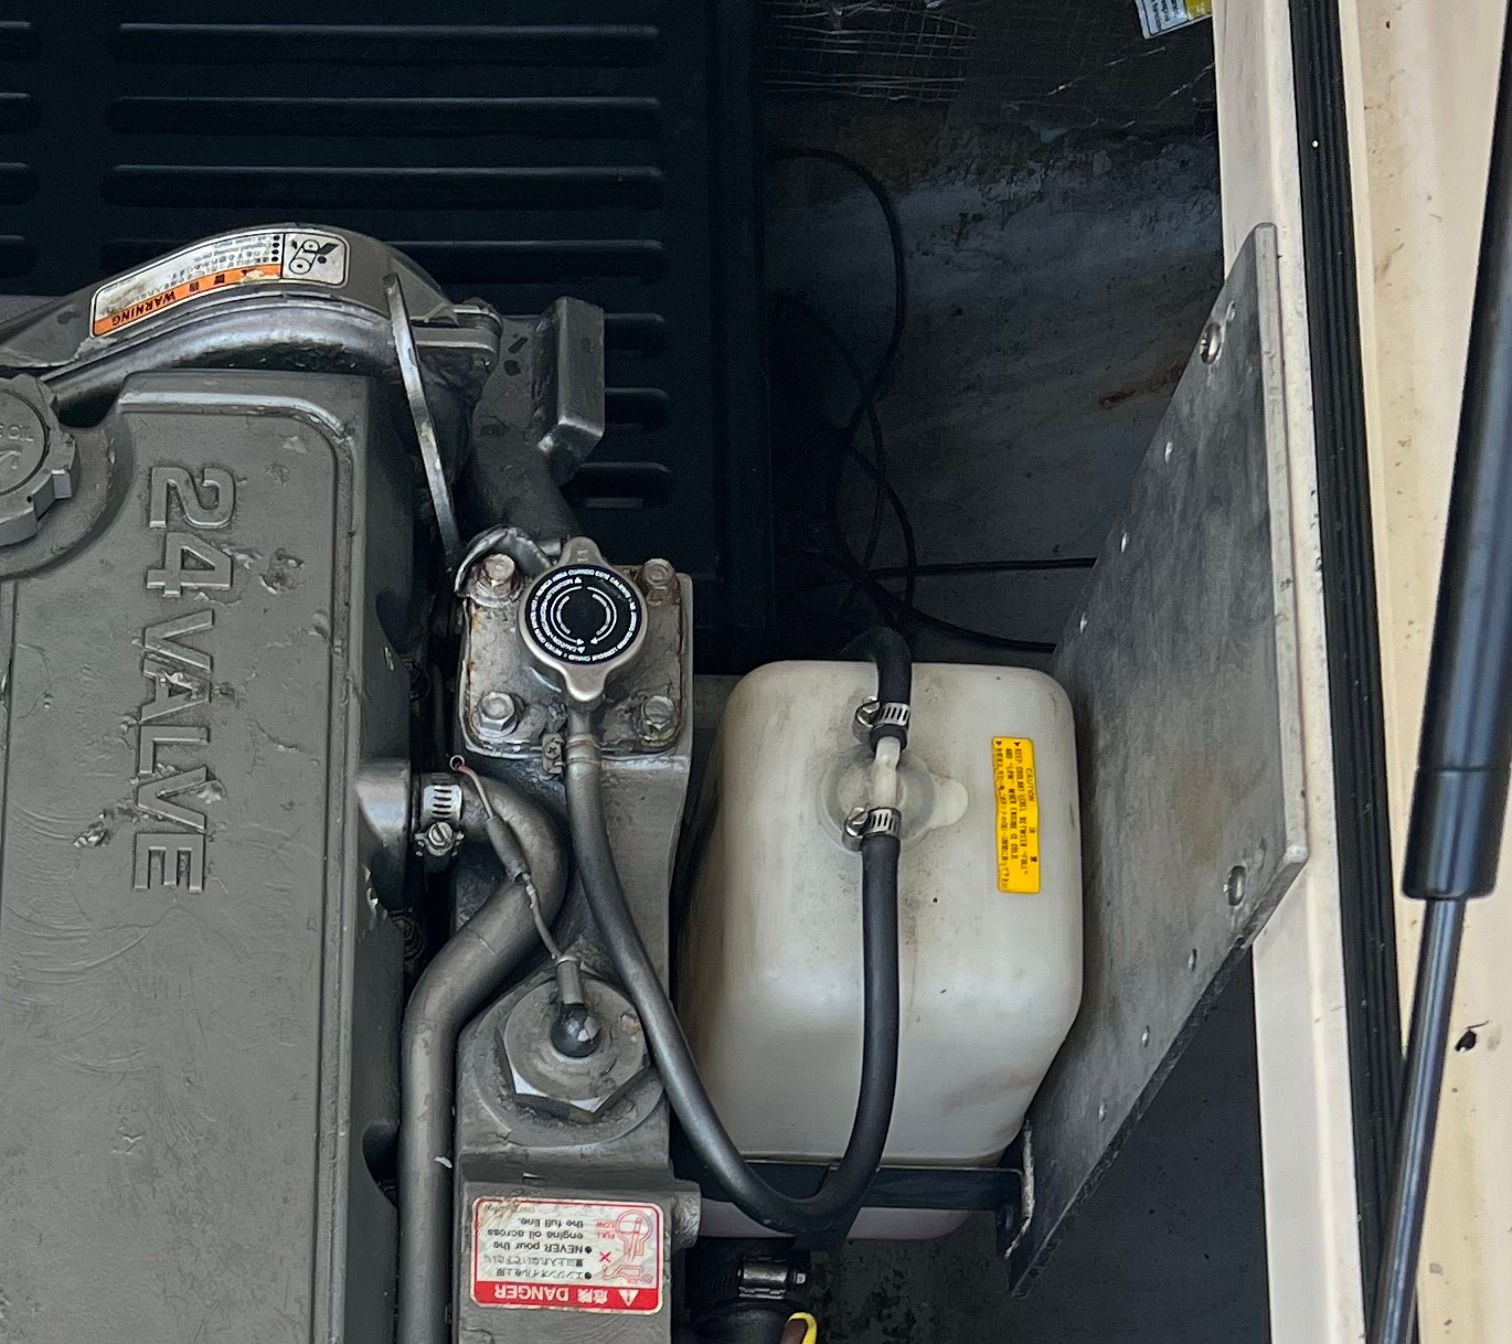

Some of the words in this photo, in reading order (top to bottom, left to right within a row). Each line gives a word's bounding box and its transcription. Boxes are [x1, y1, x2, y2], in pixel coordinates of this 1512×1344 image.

[111, 290, 176, 326] WARNING
[7, 424, 34, 442] OIL
[144, 464, 237, 598] 24
[131, 606, 214, 895] VALVE
[518, 1218, 540, 1227] line.
[545, 1220, 562, 1228] full
[566, 1220, 583, 1228] the
[488, 1229, 524, 1237] across
[529, 1231, 541, 1240] oil
[547, 1230, 584, 1239] engine
[493, 1242, 510, 1250] the
[516, 1242, 540, 1250] pour
[545, 1244, 583, 1252] NEVER
[494, 1284, 569, 1301] DANGER
